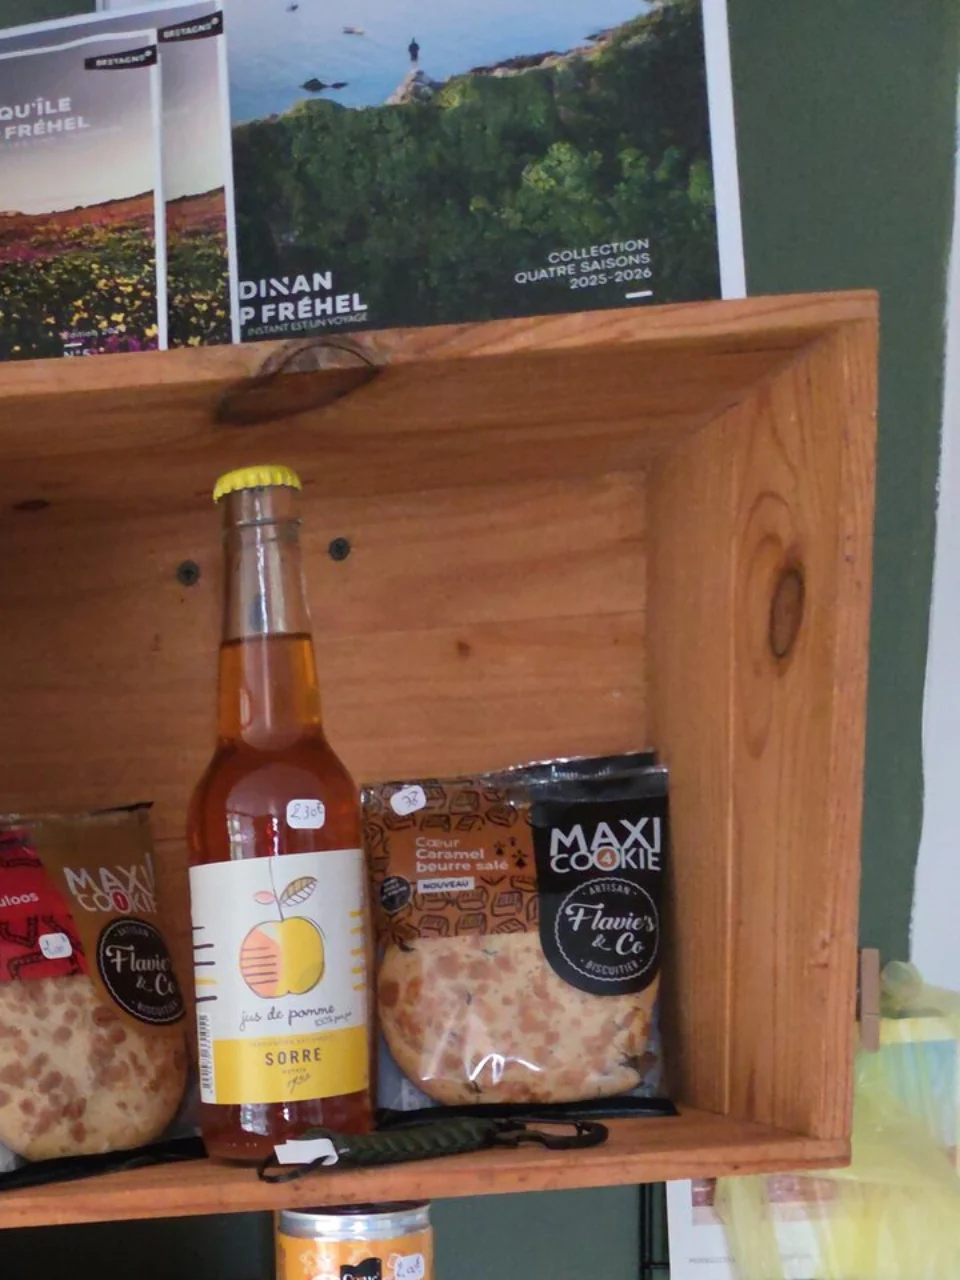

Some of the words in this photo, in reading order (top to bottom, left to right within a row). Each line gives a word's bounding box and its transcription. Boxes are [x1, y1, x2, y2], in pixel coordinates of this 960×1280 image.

[4, 116, 90, 141] FRÉHEL
[548, 239, 650, 264] COLLECTION
[514, 263, 576, 285] QUATRE
[580, 253, 651, 277] SAISONS
[570, 267, 652, 291] 2025-2026
[239, 271, 332, 300] DINAN
[261, 293, 368, 324] FRÉHEL
[415, 836, 460, 849] Cœur
[549, 817, 662, 857] MAXI
[415, 848, 485, 860] Caramel
[415, 860, 471, 873] beurre
[476, 859, 509, 872] salé
[551, 846, 662, 874] COOKIE
[62, 852, 156, 899] MAXI
[421, 879, 470, 891] NOUVEAU
[589, 883, 631, 896] ARTISAN
[565, 902, 656, 932] Flavie's
[615, 932, 646, 956] Co
[239, 1010, 262, 1032] jus
[267, 1005, 284, 1021] de
[288, 1004, 335, 1026] pomme
[265, 1047, 322, 1066] SORRE
